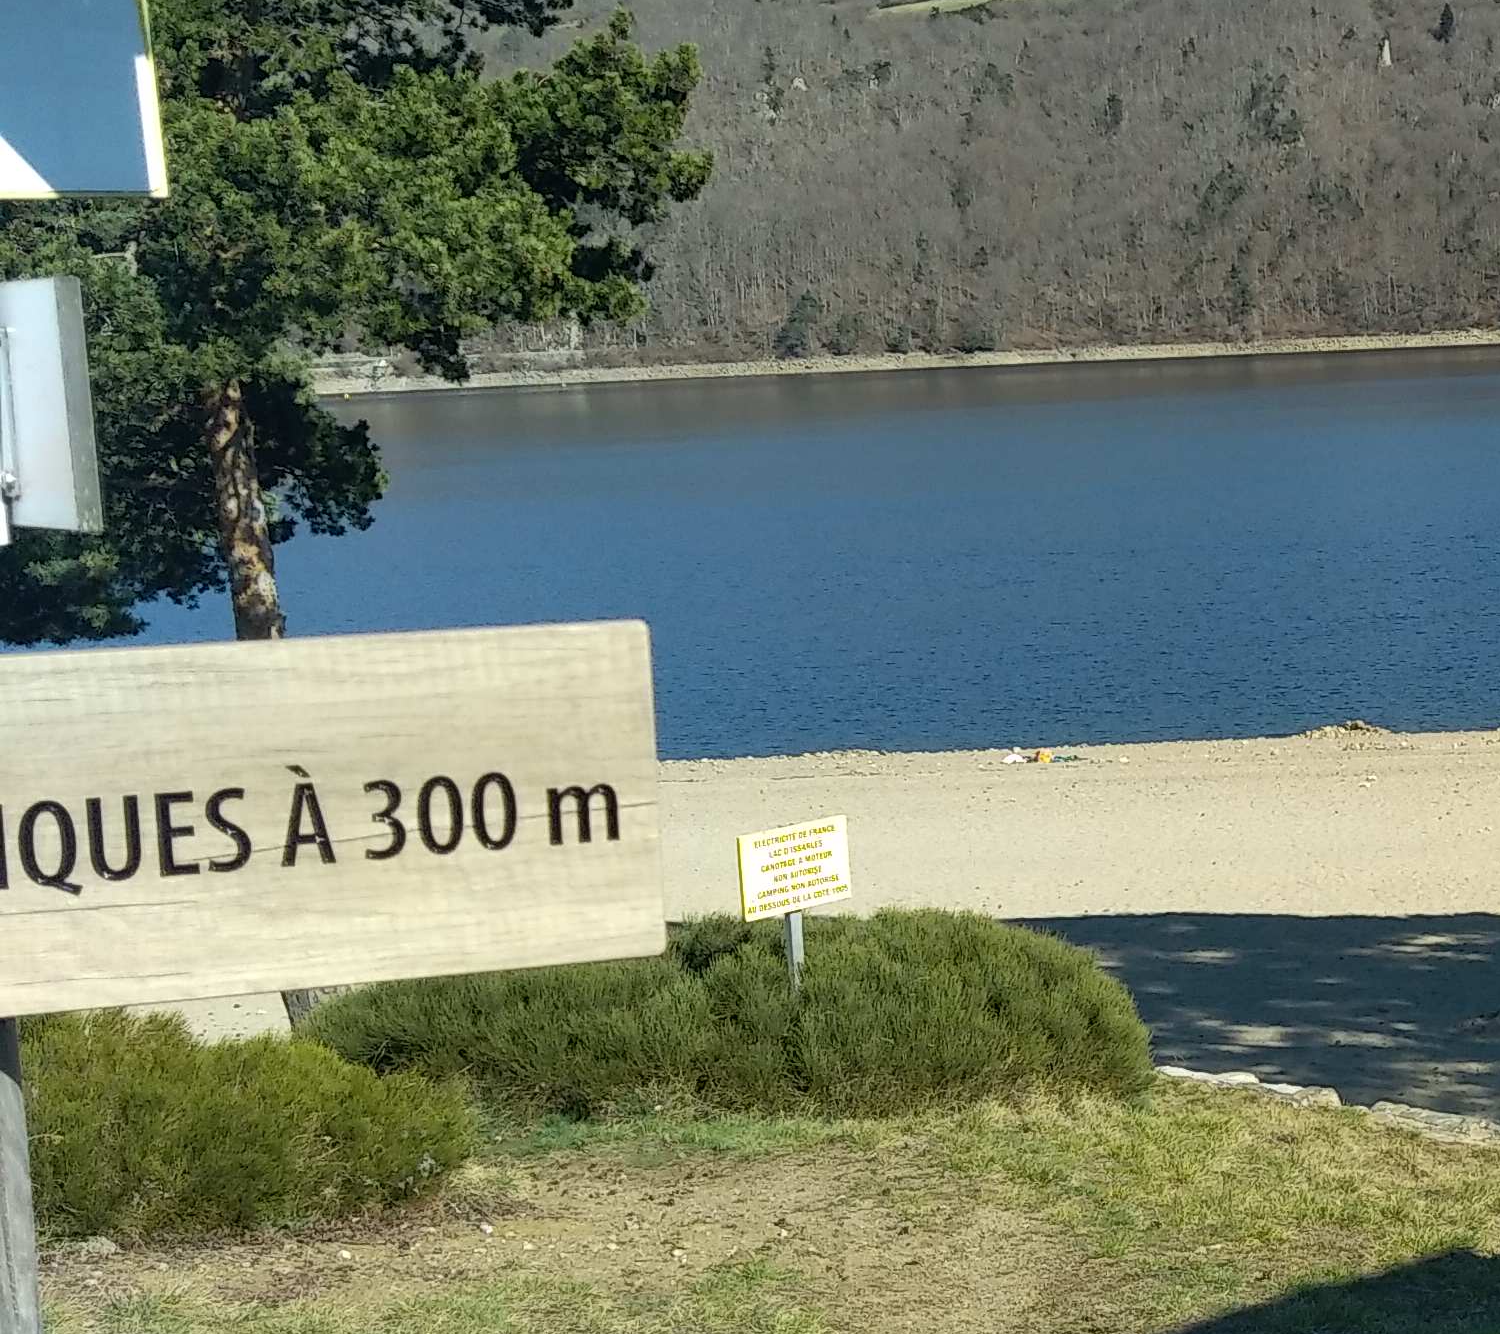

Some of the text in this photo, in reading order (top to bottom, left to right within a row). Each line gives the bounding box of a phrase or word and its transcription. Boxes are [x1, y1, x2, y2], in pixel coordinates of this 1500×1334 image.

[280, 764, 336, 867] À
[363, 771, 518, 861] 300
[546, 782, 620, 846] m
[809, 825, 835, 837] FRANCE
[804, 850, 833, 862] MOTEUR
[773, 873, 788, 882] NON
[757, 885, 790, 900] CAMPING
[791, 881, 806, 891] NON
[747, 906, 757, 914] AU
[759, 898, 791, 911] DESSOUS
